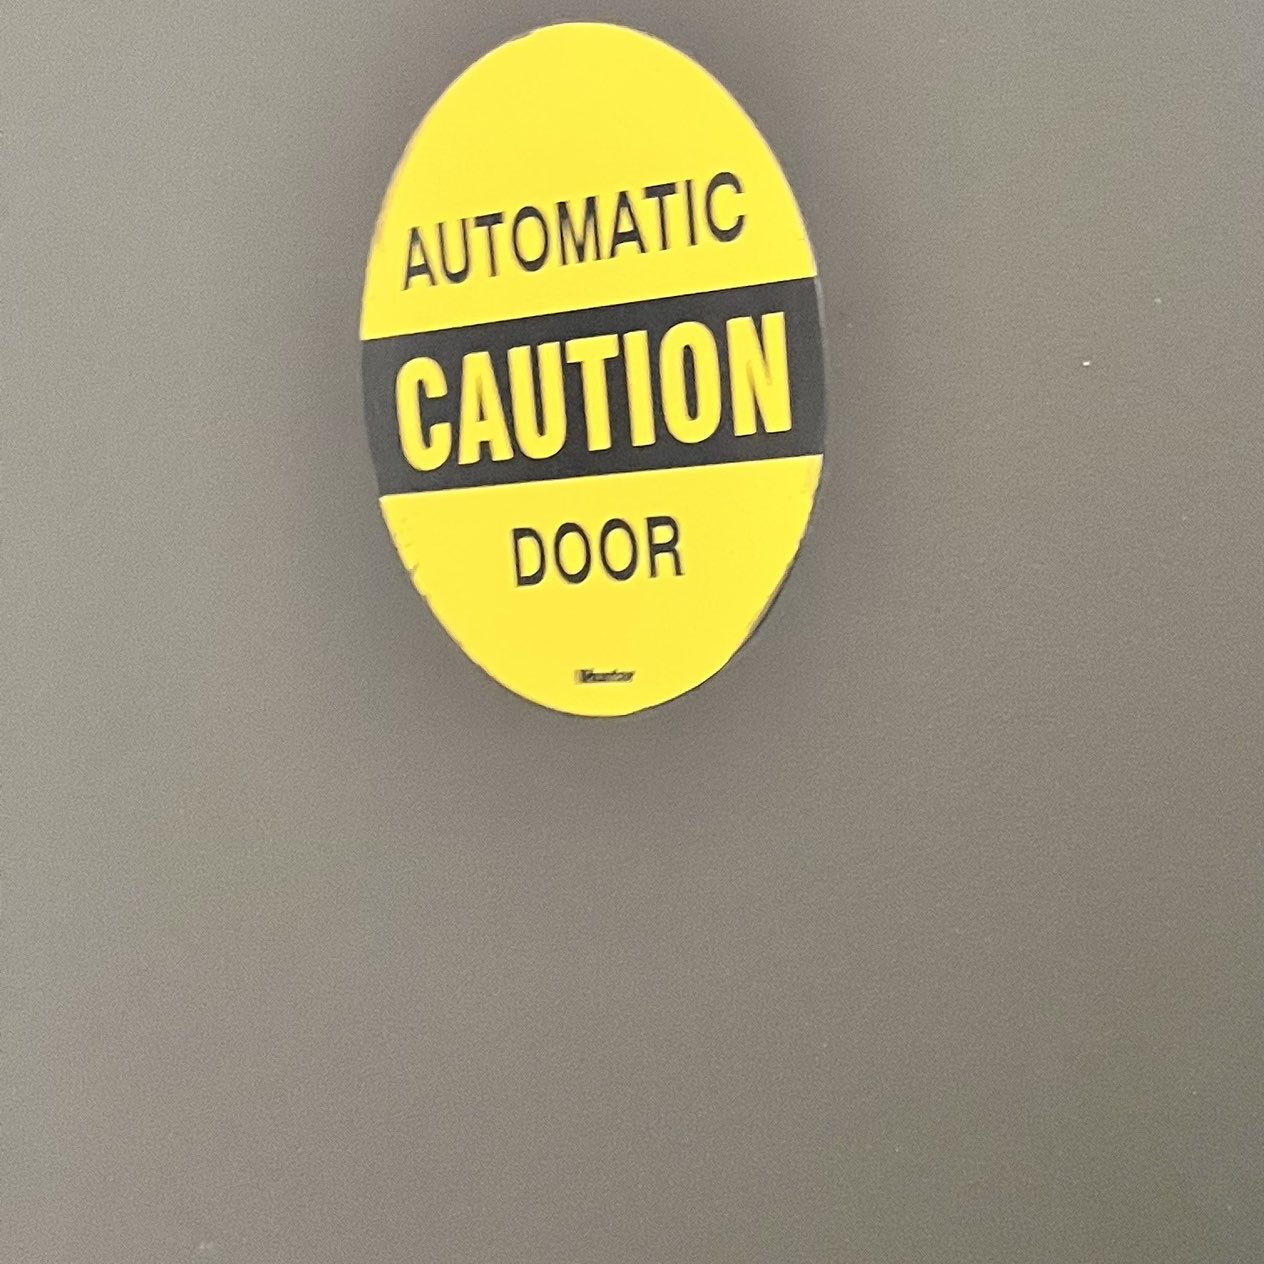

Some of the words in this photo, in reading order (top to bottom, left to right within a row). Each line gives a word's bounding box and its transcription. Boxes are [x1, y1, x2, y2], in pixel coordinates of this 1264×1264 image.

[402, 171, 746, 292] AUTOMATIC
[395, 313, 793, 472] CAUTION
[510, 515, 685, 588] DOOR
